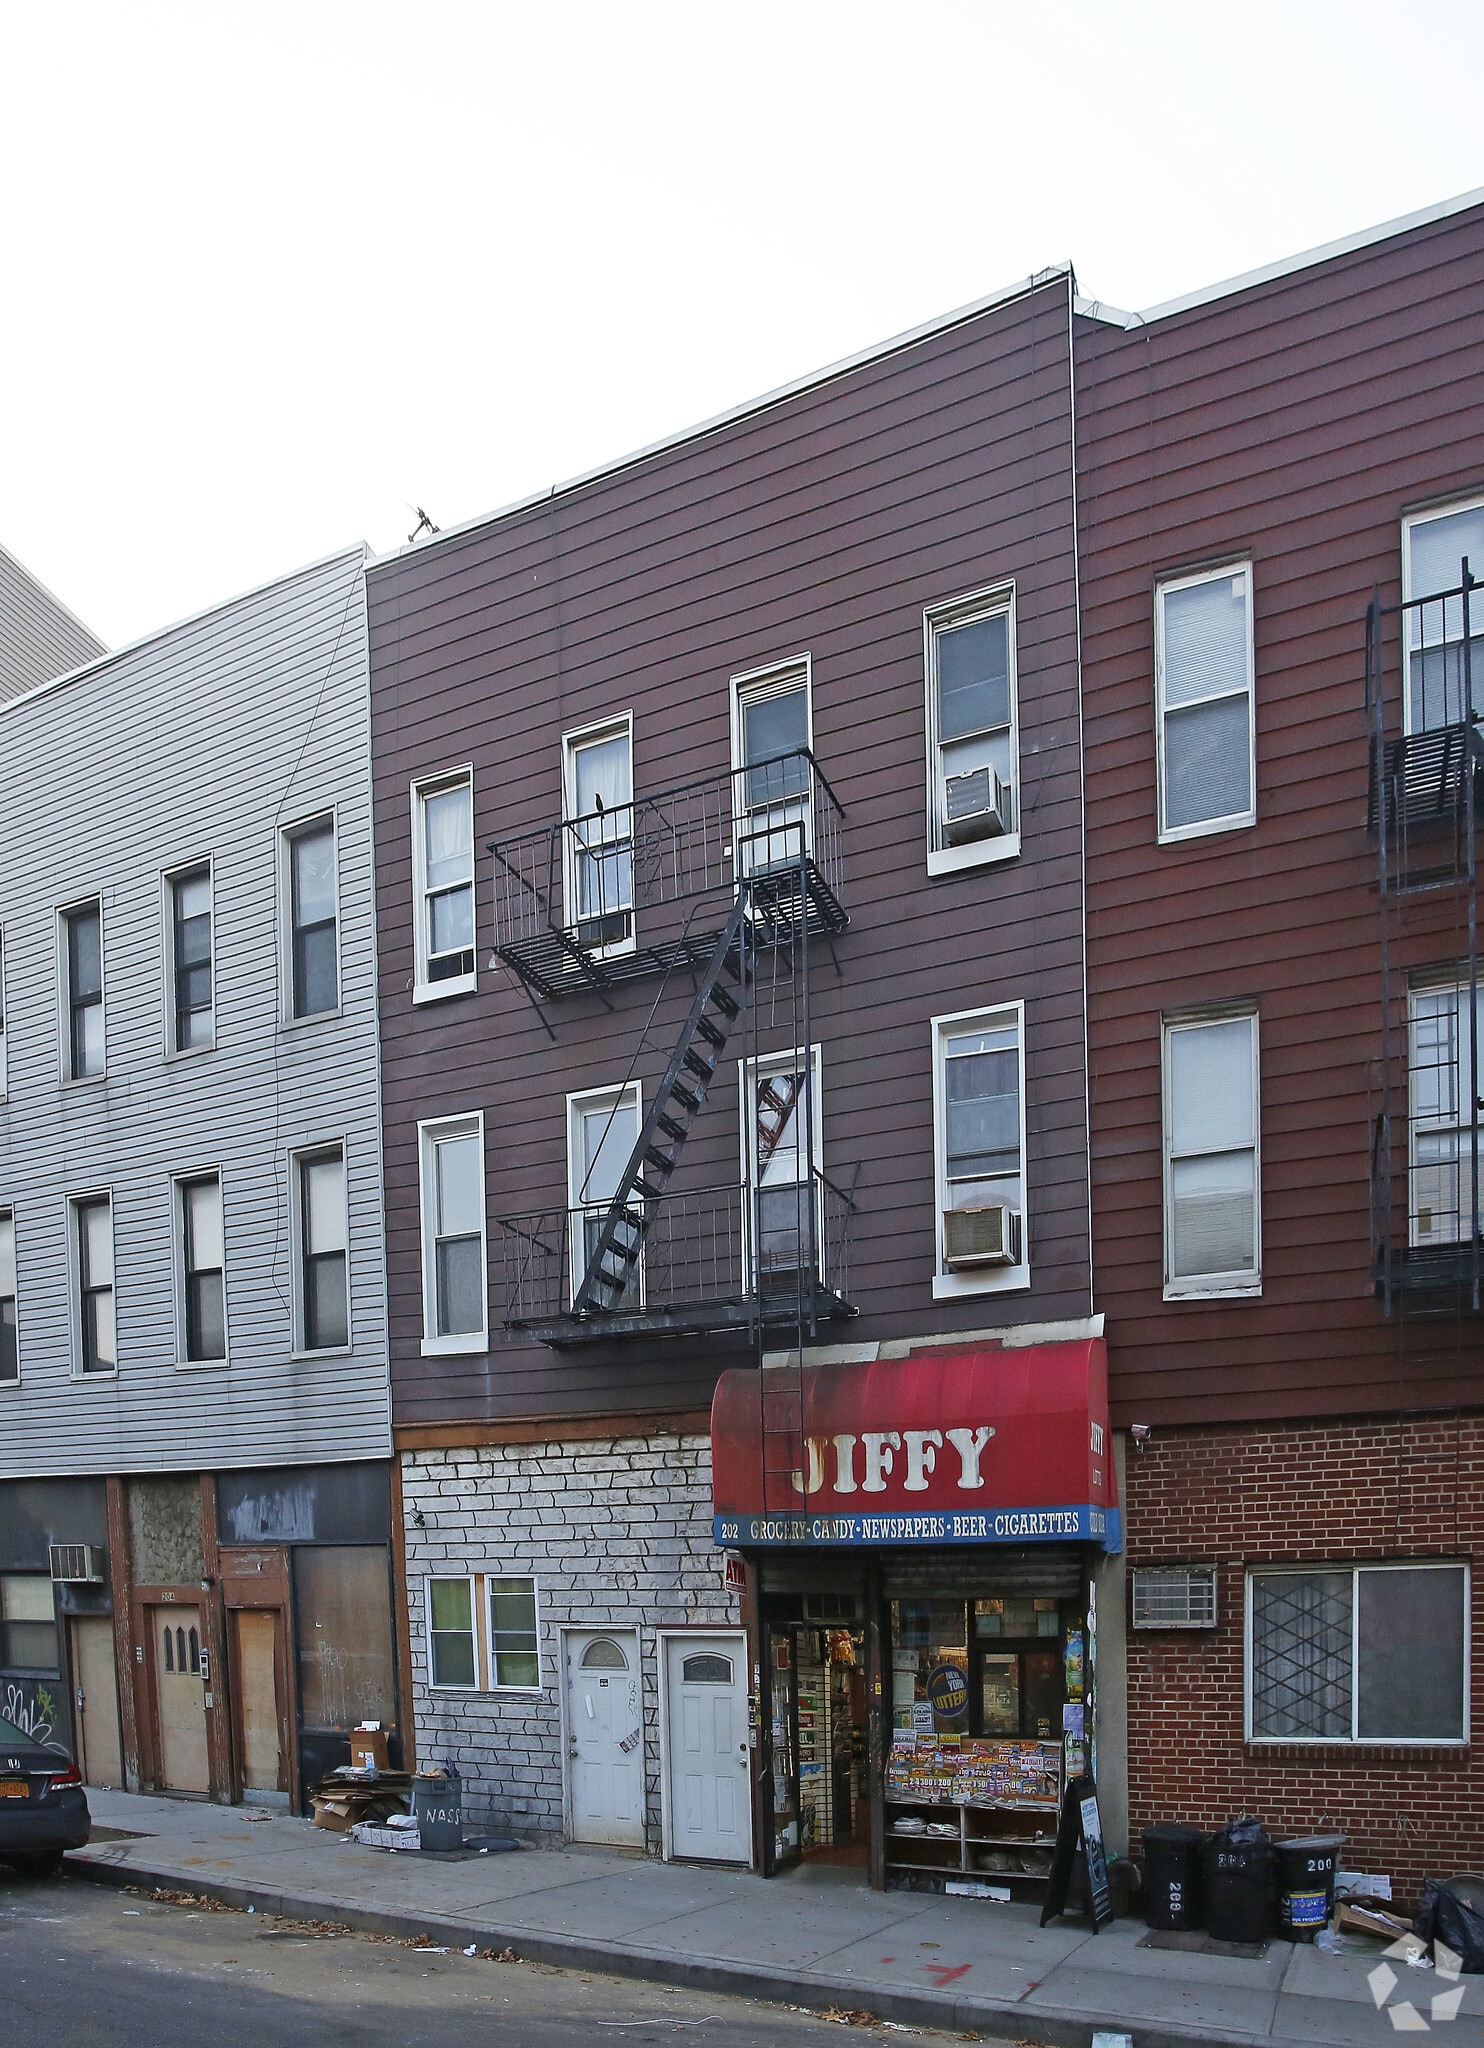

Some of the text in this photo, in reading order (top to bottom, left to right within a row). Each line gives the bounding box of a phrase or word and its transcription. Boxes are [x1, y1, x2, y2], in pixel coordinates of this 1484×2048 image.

[791, 1426, 997, 1494] JIFFY
[721, 1522, 739, 1539] 202
[750, 1519, 807, 1540] GROCERY
[812, 1519, 856, 1540] CANDY
[861, 1516, 945, 1540] NEWSPAPERS
[952, 1515, 987, 1537] BEER
[994, 1511, 1080, 1536] CIGARETTES
[726, 1559, 747, 1586] ATM
[945, 1671, 960, 1680] NEW
[947, 1678, 966, 1692] YORK
[933, 1689, 968, 1710] LOTTERY
[1307, 1858, 1333, 1872] 200
